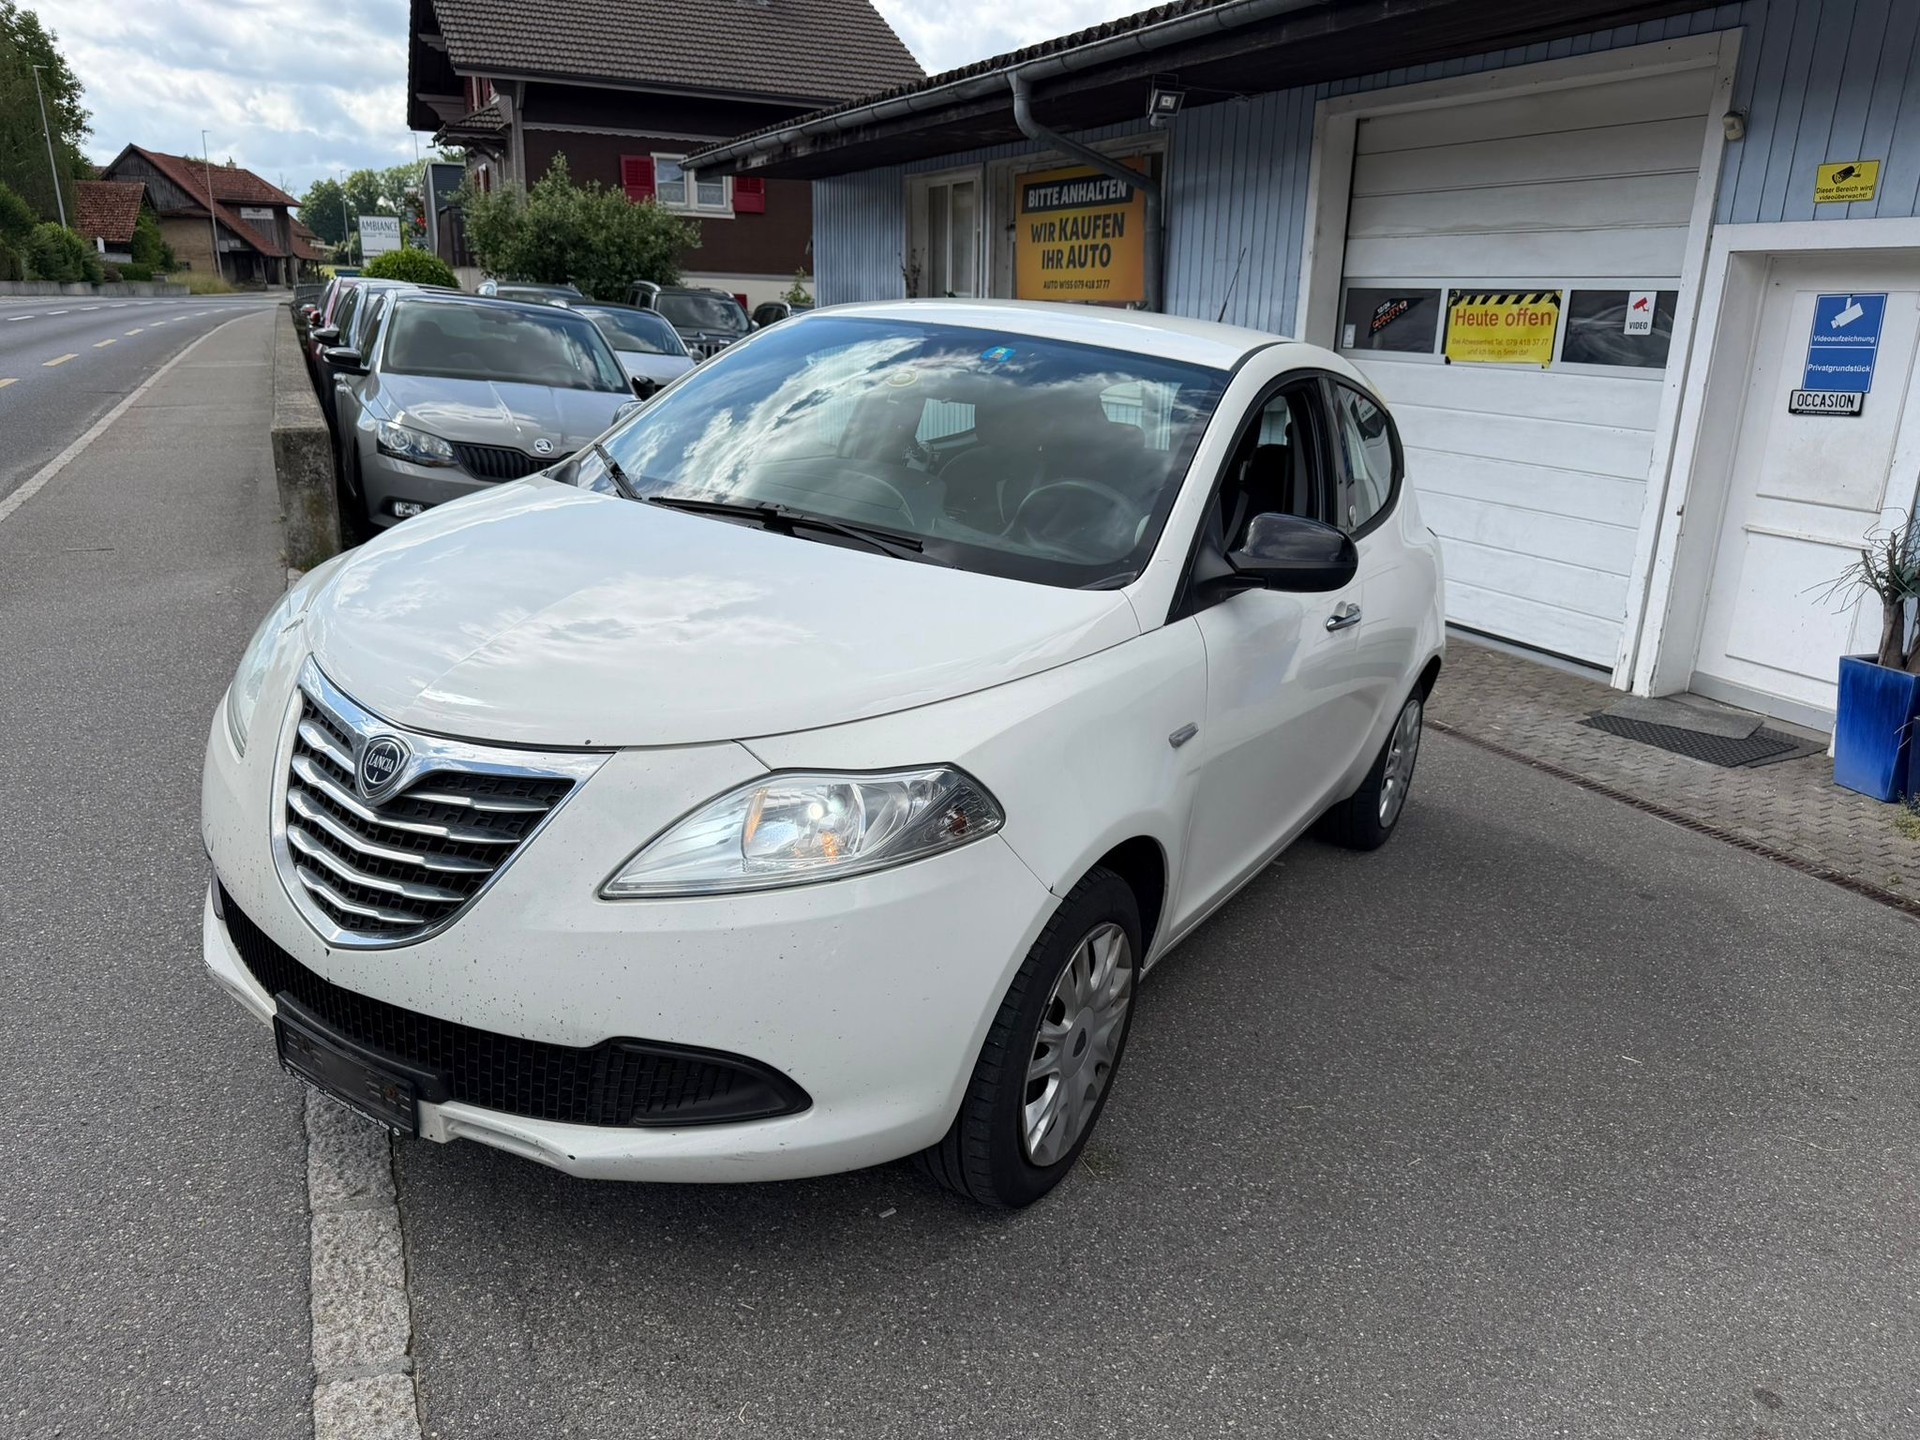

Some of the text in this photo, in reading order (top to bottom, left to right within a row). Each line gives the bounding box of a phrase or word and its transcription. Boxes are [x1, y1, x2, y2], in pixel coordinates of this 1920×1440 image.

[1028, 179, 1127, 208] BITTE ANHALTEN
[1816, 186, 1834, 194] Dieser
[1836, 185, 1858, 193] Bereich
[361, 220, 398, 232] AMBIANCE
[1031, 212, 1125, 243] WIR KAUFEN
[1042, 243, 1111, 270] IHR AUTO
[1043, 280, 1058, 289] AUTO
[1103, 279, 1110, 289] 77
[1454, 308, 1552, 327] Heute offen
[1629, 321, 1648, 330] VIDEO
[1506, 338, 1518, 346] 079
[1814, 334, 1875, 344] Videoaufzeichnung
[1807, 363, 1871, 373] Privatgrundstück
[1797, 393, 1855, 409] OCCASION
[368, 753, 395, 773] LANCIA
